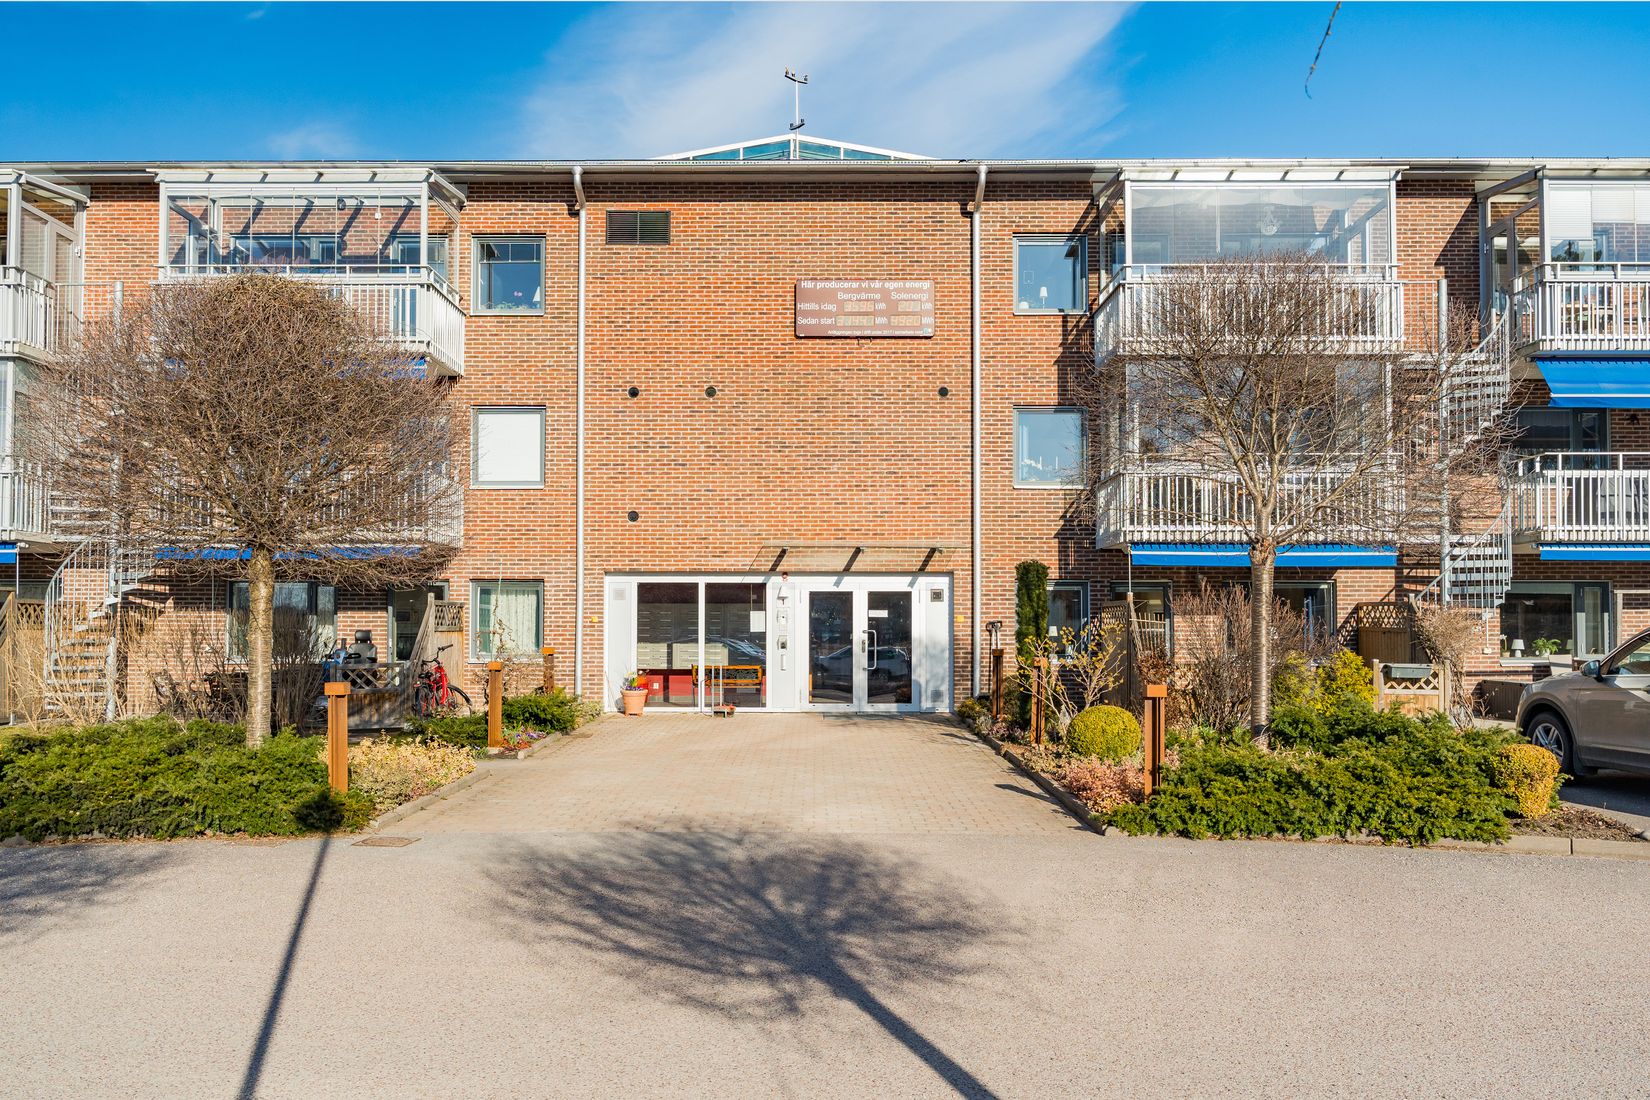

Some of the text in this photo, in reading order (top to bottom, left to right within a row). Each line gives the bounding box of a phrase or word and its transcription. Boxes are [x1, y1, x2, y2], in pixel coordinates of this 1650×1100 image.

[801, 279, 930, 290] Här producerar vi vår egen energi
[837, 291, 881, 301] Bergvärme
[891, 291, 929, 301] Solenergi
[797, 302, 837, 312] Hittills idag
[797, 316, 835, 325] Sedan start
